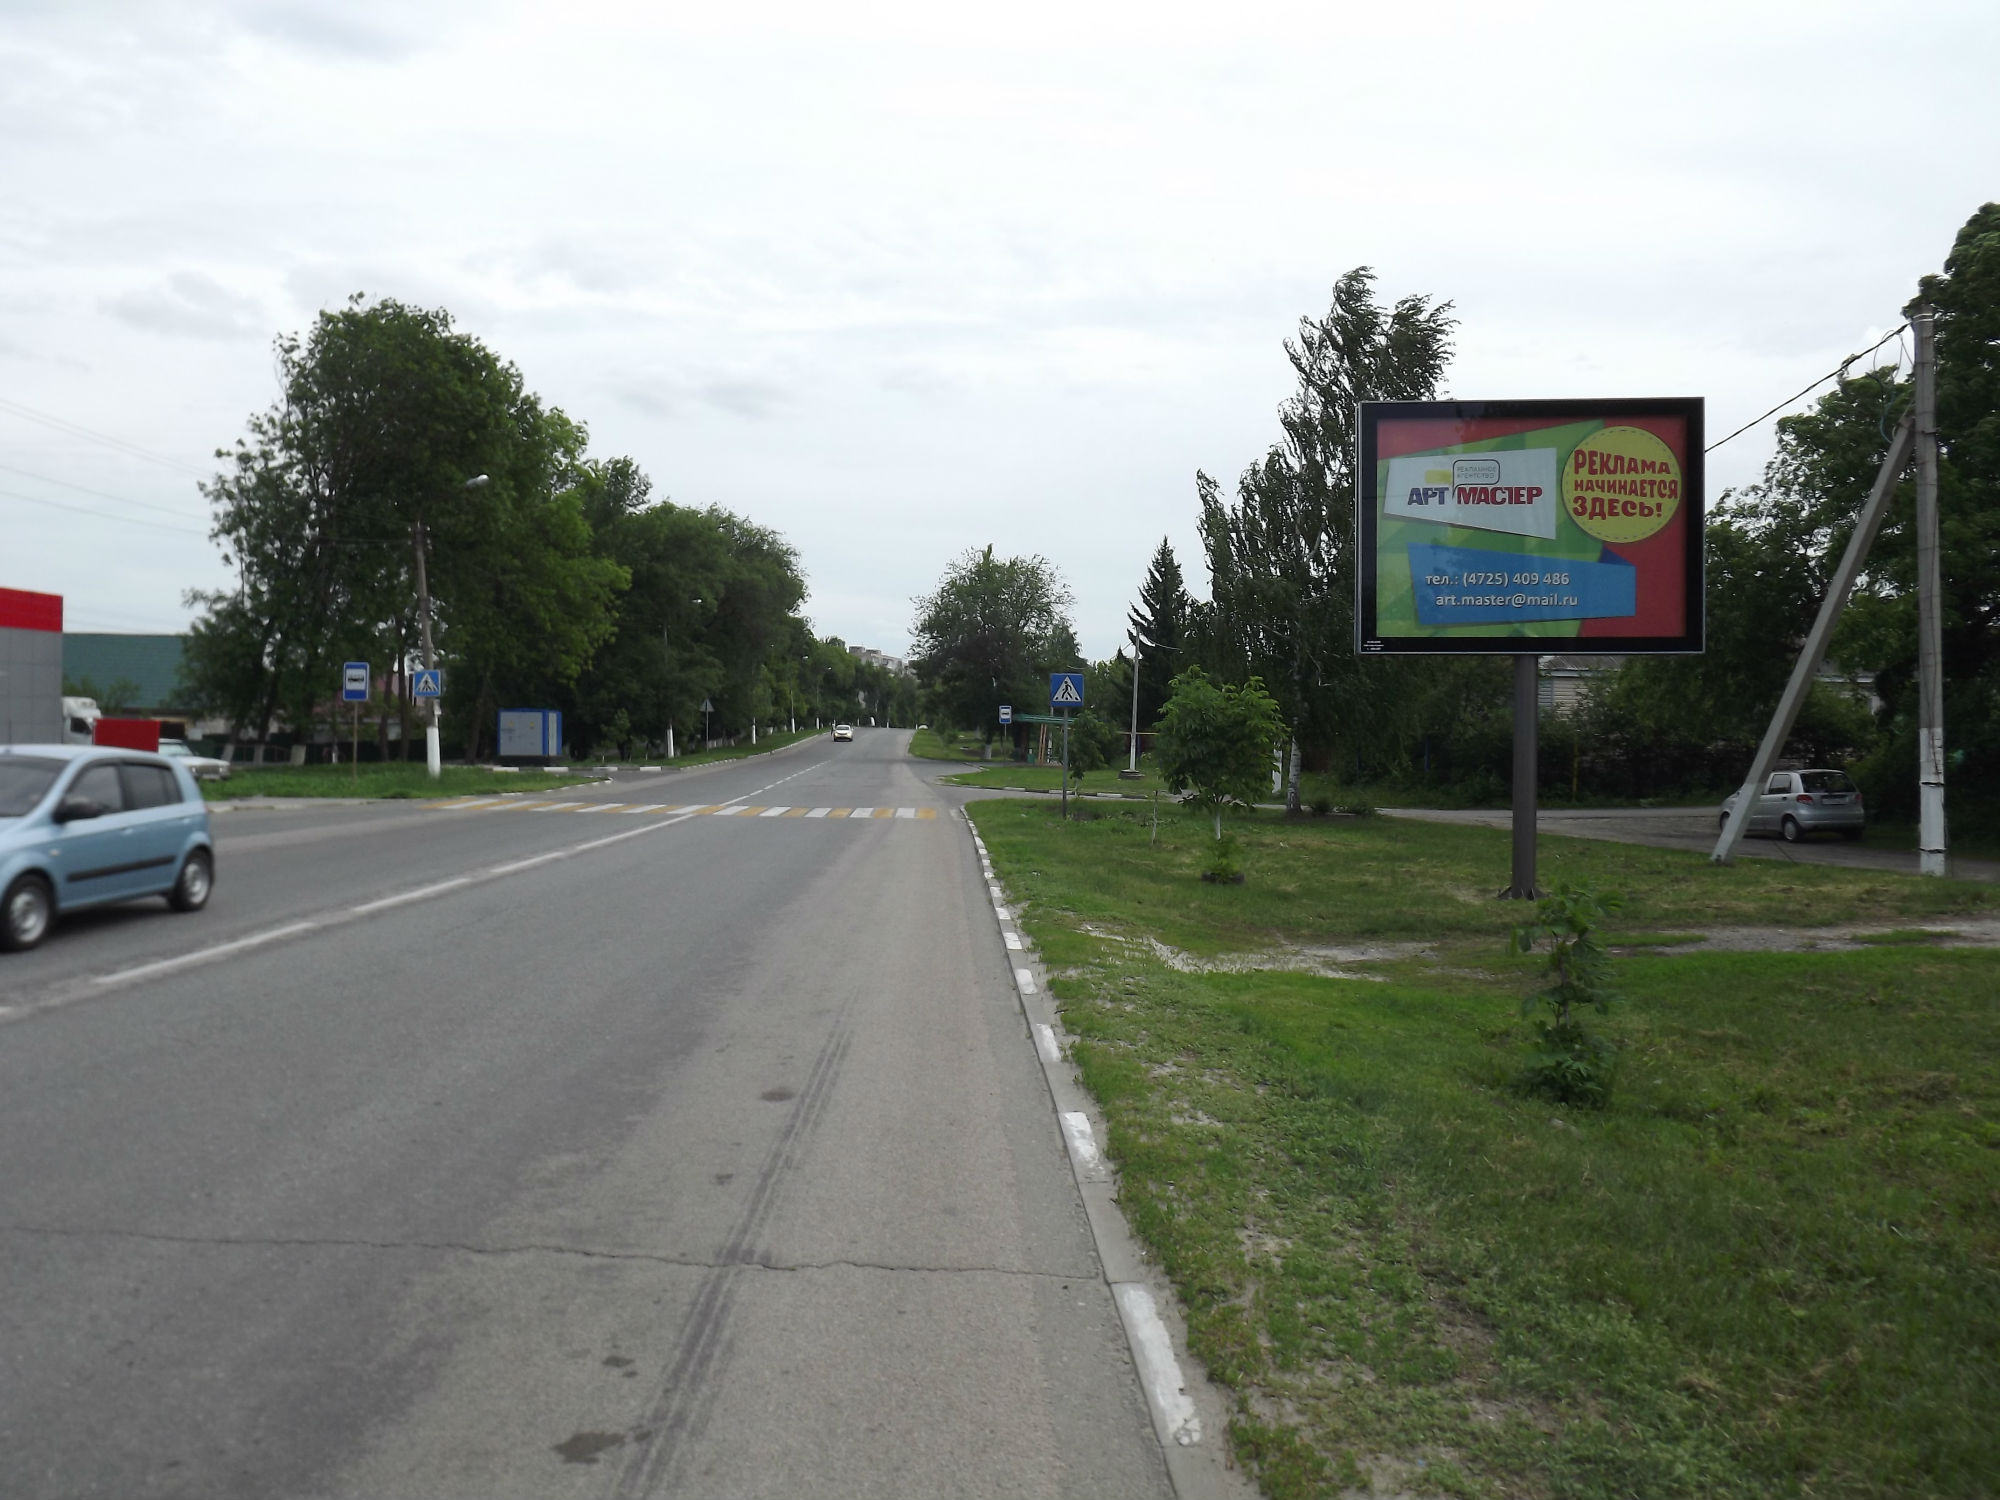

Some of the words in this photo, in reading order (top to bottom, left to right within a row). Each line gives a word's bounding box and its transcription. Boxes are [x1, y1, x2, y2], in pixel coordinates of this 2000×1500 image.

[1574, 449, 1671, 475] РЕКЛАМА
[1407, 487, 1449, 505] АРТ
[1456, 487, 1543, 505] МАСТЕР
[1574, 479, 1678, 499] НАЧИНАЕТСЯ
[1572, 496, 1663, 520] ЗДЕСЬ!
[1425, 574, 1459, 585] тел.:
[1462, 572, 1509, 588] (4725)
[1512, 572, 1539, 585] 409
[1543, 572, 1570, 585] 486
[1435, 593, 1579, 608] art.master@mail.ru
